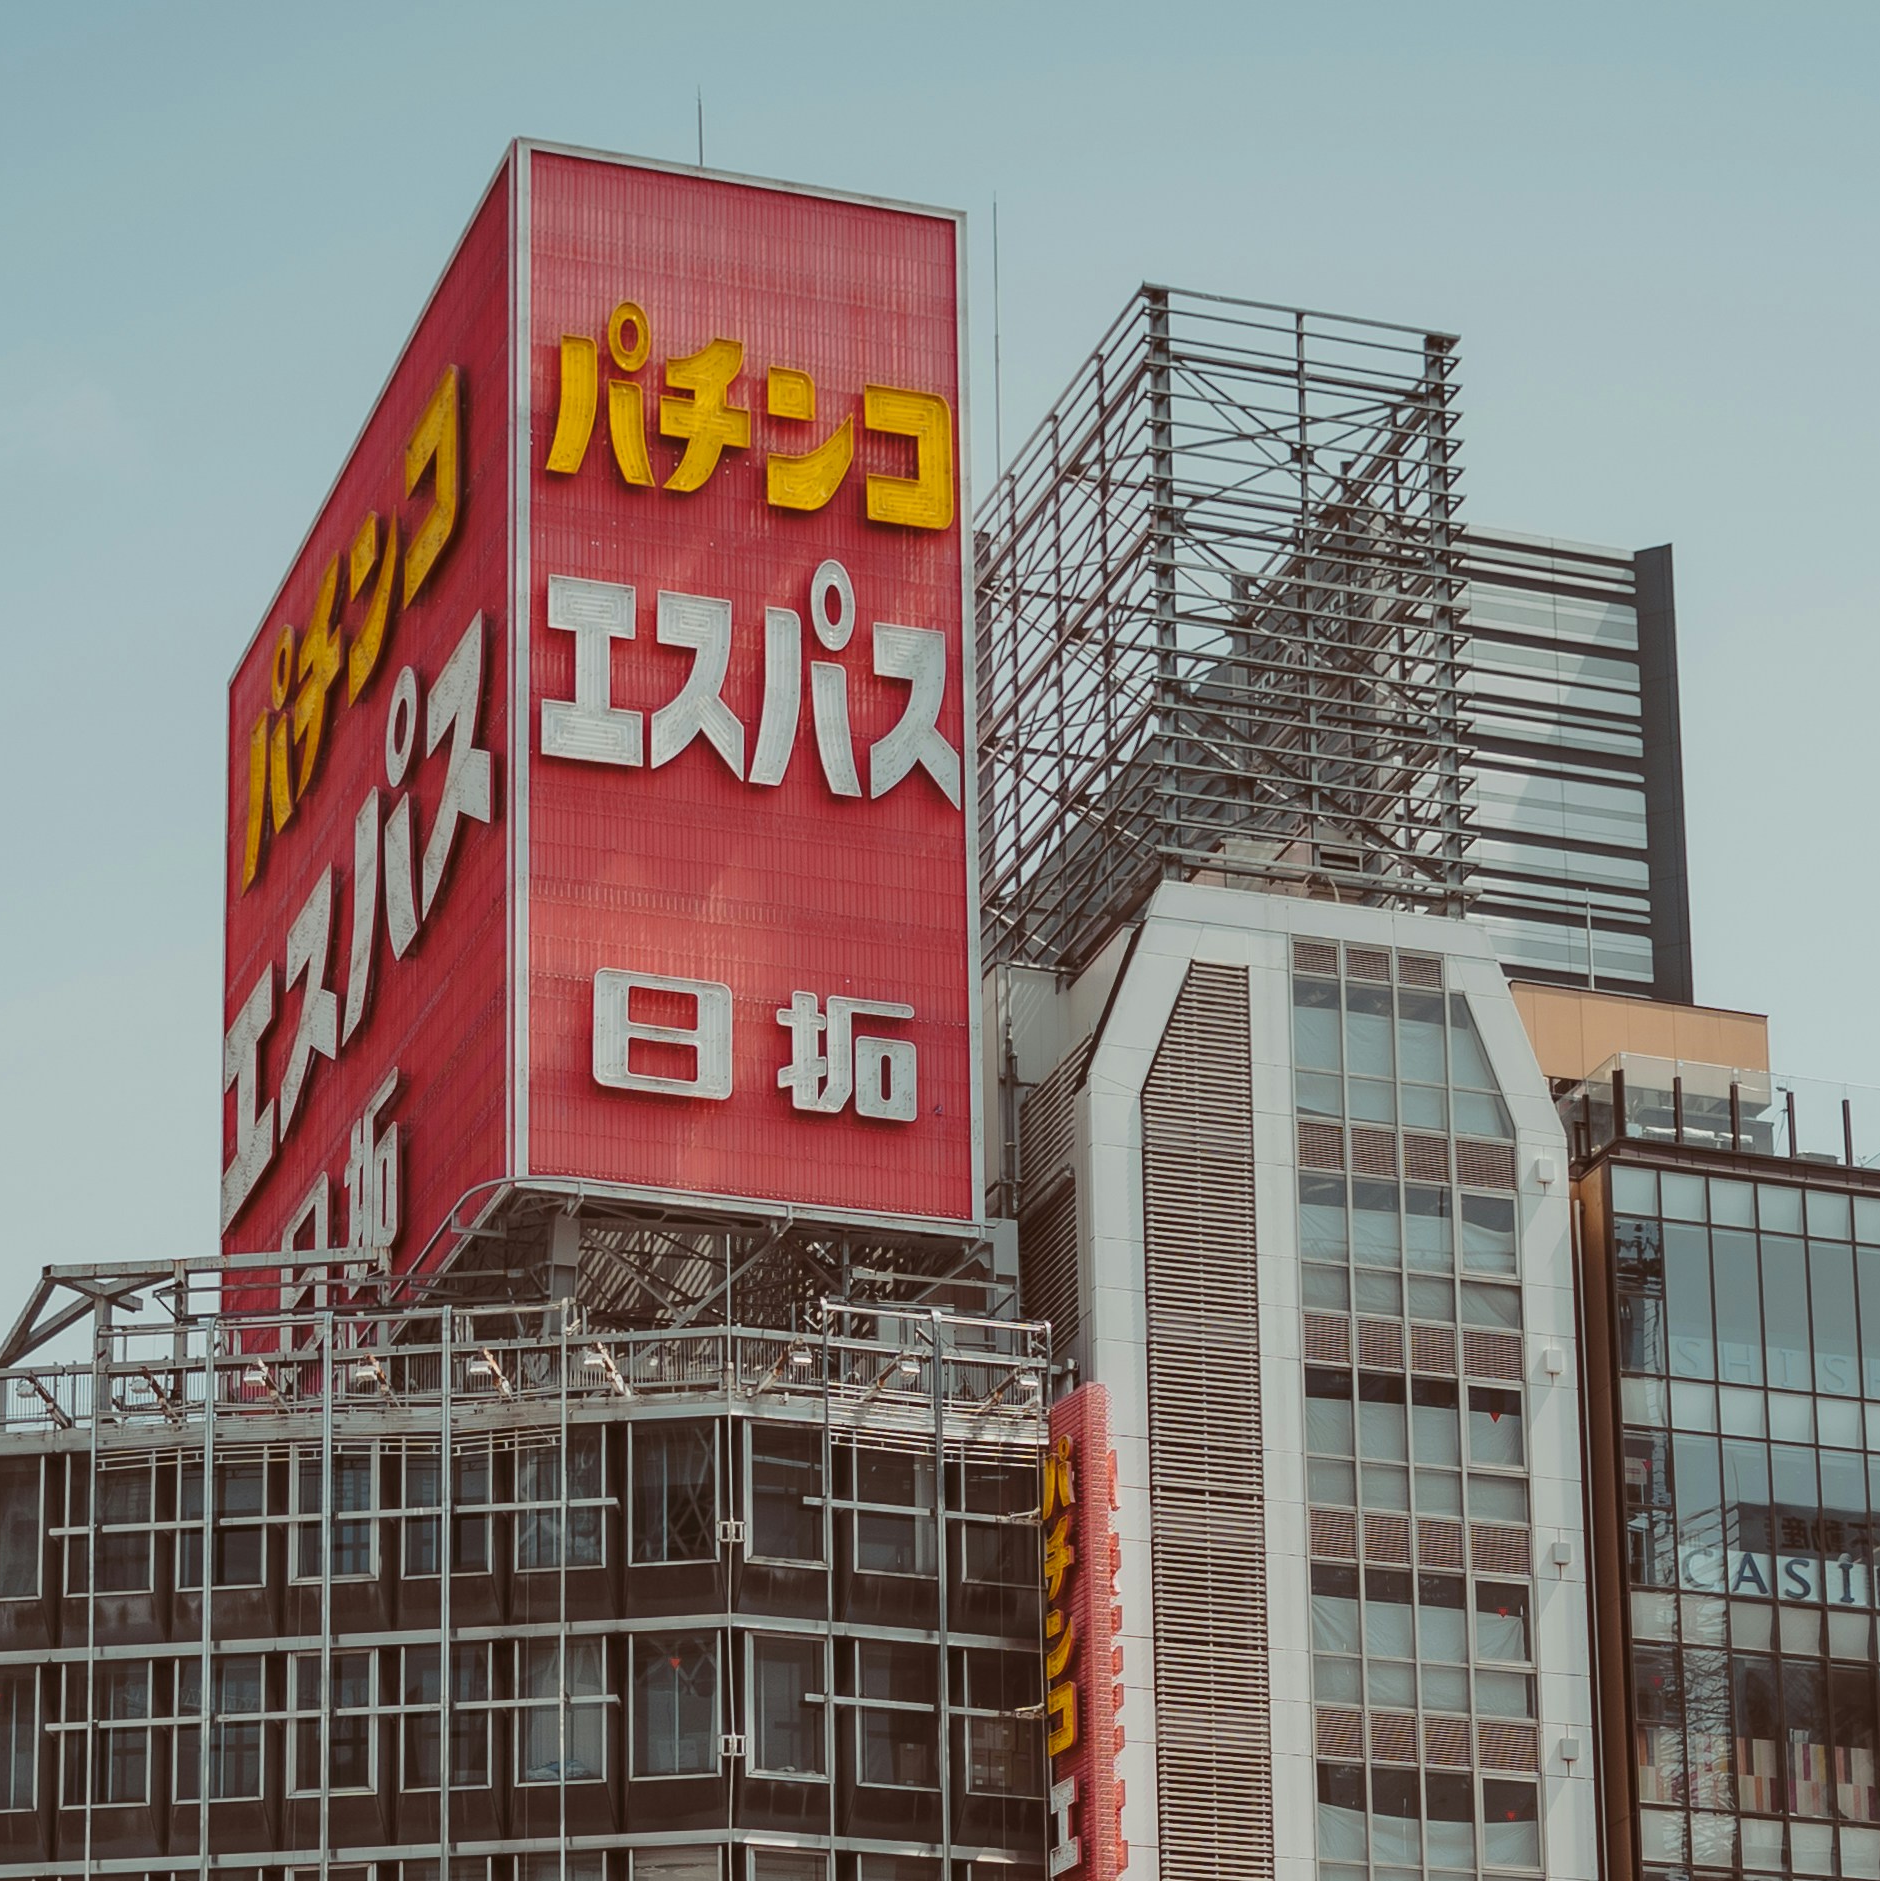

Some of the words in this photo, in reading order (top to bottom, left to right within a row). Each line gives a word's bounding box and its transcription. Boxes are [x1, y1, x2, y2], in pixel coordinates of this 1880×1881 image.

[545, 301, 957, 532] パチンコ
[241, 362, 462, 895] パチンコ
[539, 559, 962, 810] エスパス
[221, 610, 493, 1232] エスパス
[592, 968, 918, 1124] 日拓
[1042, 1435, 1079, 1758] パチンコ
